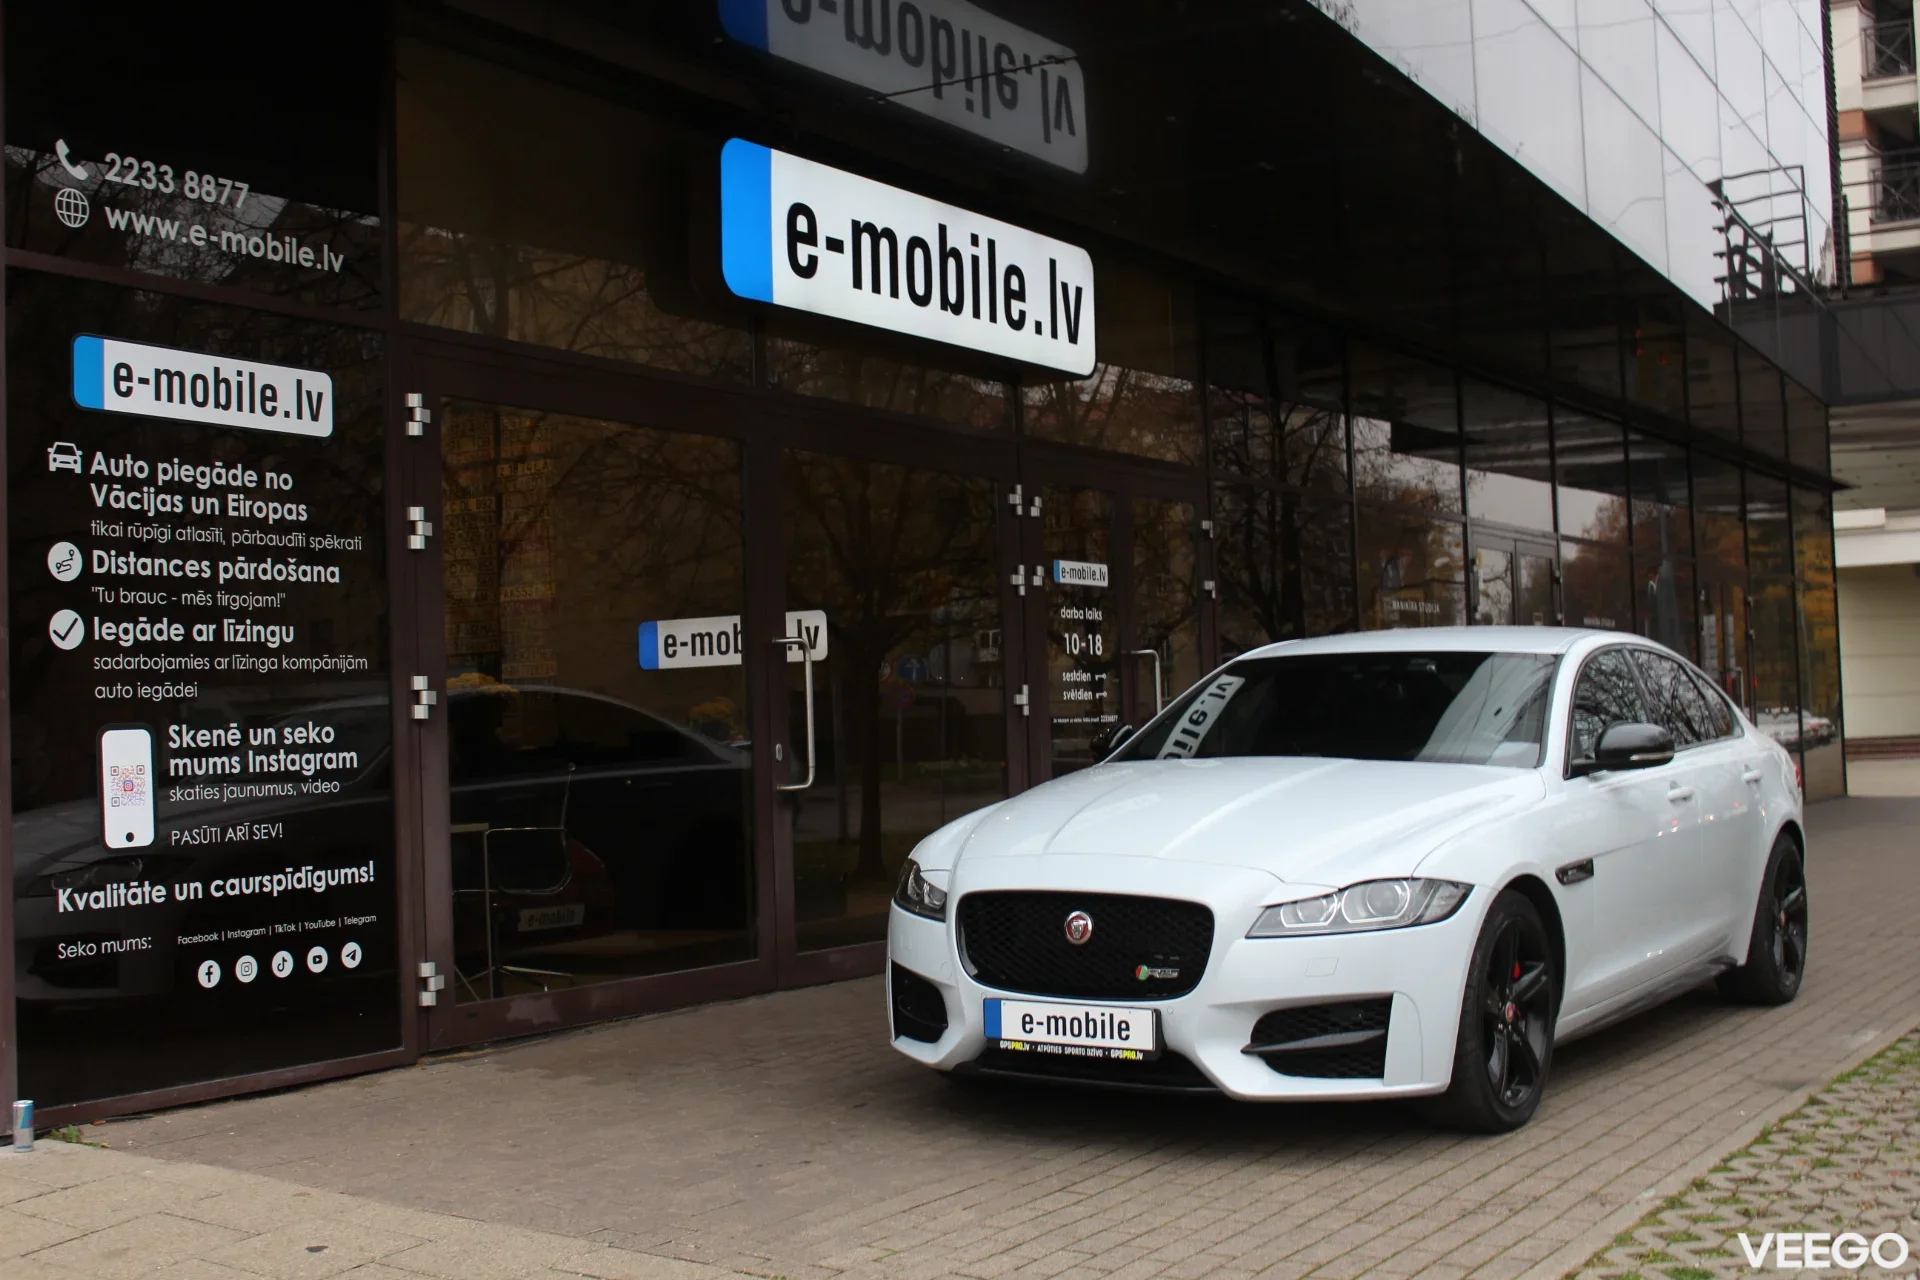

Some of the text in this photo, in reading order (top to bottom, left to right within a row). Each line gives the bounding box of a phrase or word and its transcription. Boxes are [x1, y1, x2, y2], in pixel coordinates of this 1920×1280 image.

[105, 153, 249, 208] 2233 8877
[104, 207, 344, 273] www.e-mobile.lv
[786, 202, 1083, 345] e-mobile.lv
[113, 361, 324, 422] e-mobile.lv
[90, 452, 292, 490] Auto piegāde no
[91, 483, 307, 524] Vācijas un Eiropas
[91, 520, 361, 551] tikai rūpīgi atlasīti, pārbaudīti spēkrati
[93, 550, 339, 584] Distances pārdošana
[1061, 565, 1106, 583] e-mobile.lv
[120, 588, 166, 604] brauc
[182, 591, 212, 605] mēs
[1061, 606, 1102, 620] darba laiks
[94, 617, 293, 648] Iegāde ar līzingu
[94, 654, 367, 673] sadarbojamies ar līzinga kompānijām
[1063, 670, 1091, 681] sestdien
[95, 682, 197, 701] auto iegādei
[1064, 689, 1092, 700] svētdien
[169, 722, 334, 748] Skenē un seko
[170, 749, 357, 776] mums Instagram
[170, 779, 339, 802] skaties jaunumus, video
[172, 823, 282, 845] PASŪTI ARĪ SEV!
[59, 861, 374, 912] Kvalitāte un caurspīdīgums!
[178, 916, 376, 944] Facebook Instagram TikTok YouTube Telegram
[59, 937, 151, 958] Seko mums:
[1021, 1011, 1131, 1041] e-mobile
